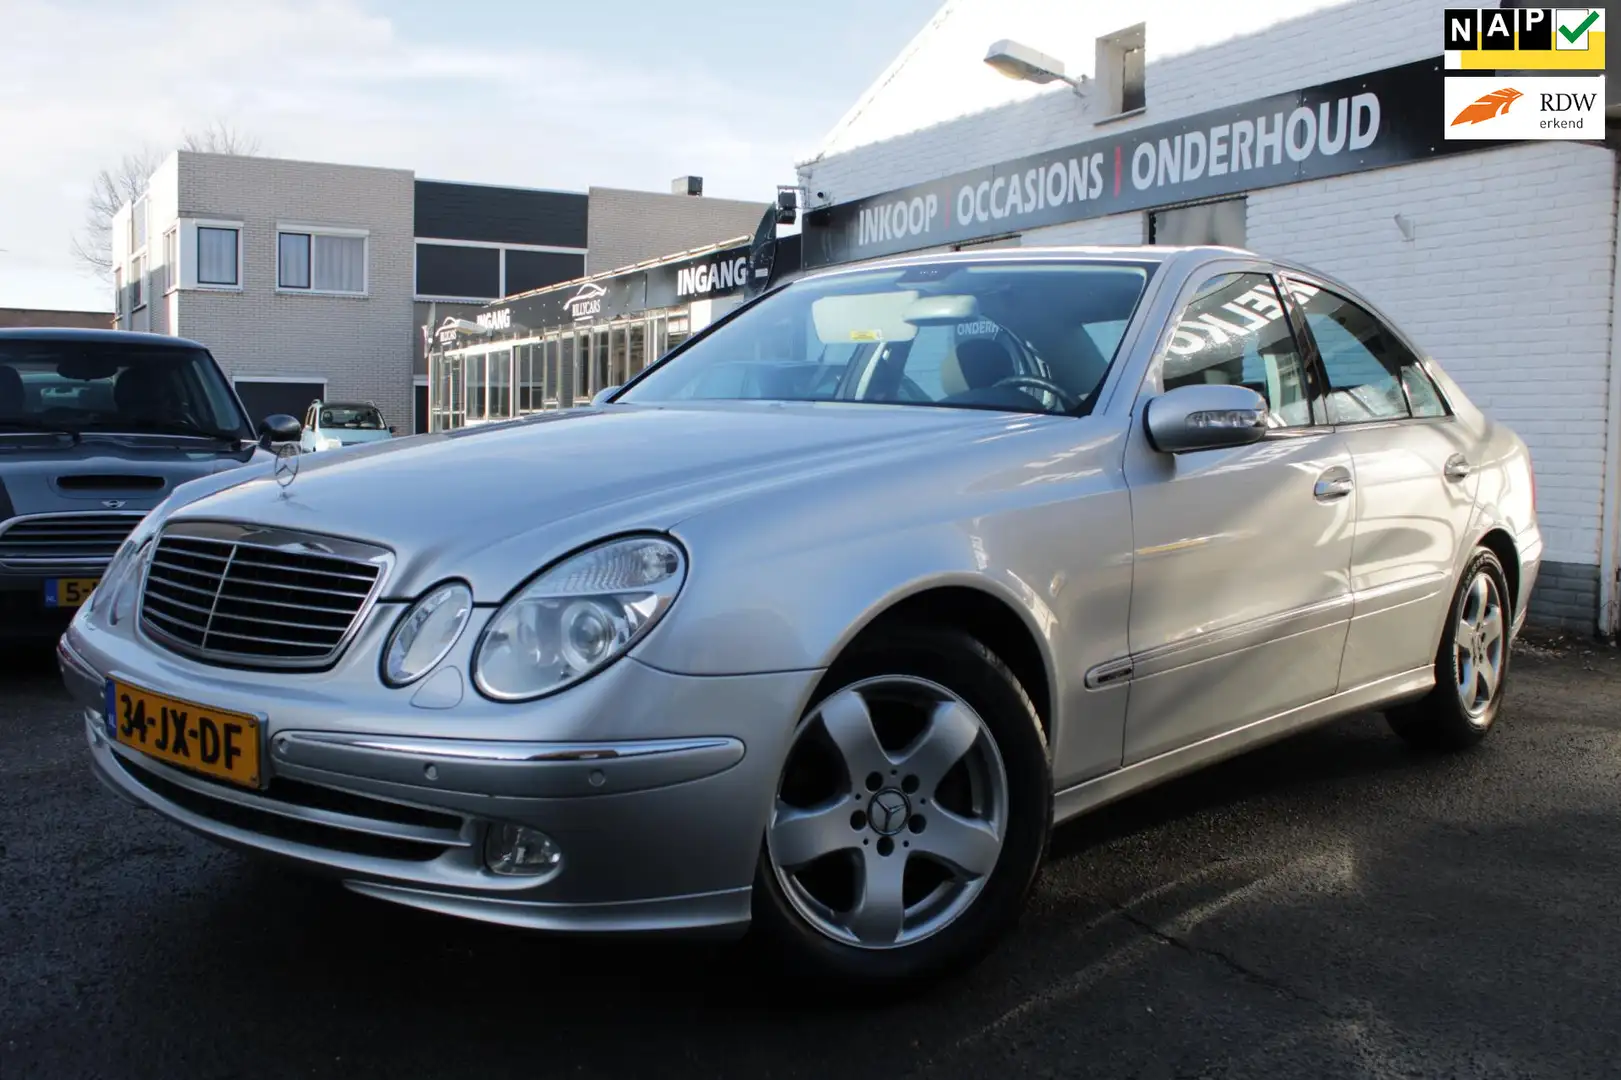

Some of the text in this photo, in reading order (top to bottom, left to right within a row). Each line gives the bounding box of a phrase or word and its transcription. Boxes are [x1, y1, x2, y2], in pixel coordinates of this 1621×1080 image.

[859, 92, 1381, 246] INKOOP OCCASIONS ONDERHOUD
[677, 256, 747, 296] INGANG
[66, 582, 98, 602] 5-
[120, 693, 243, 770] 34-JX-DF
